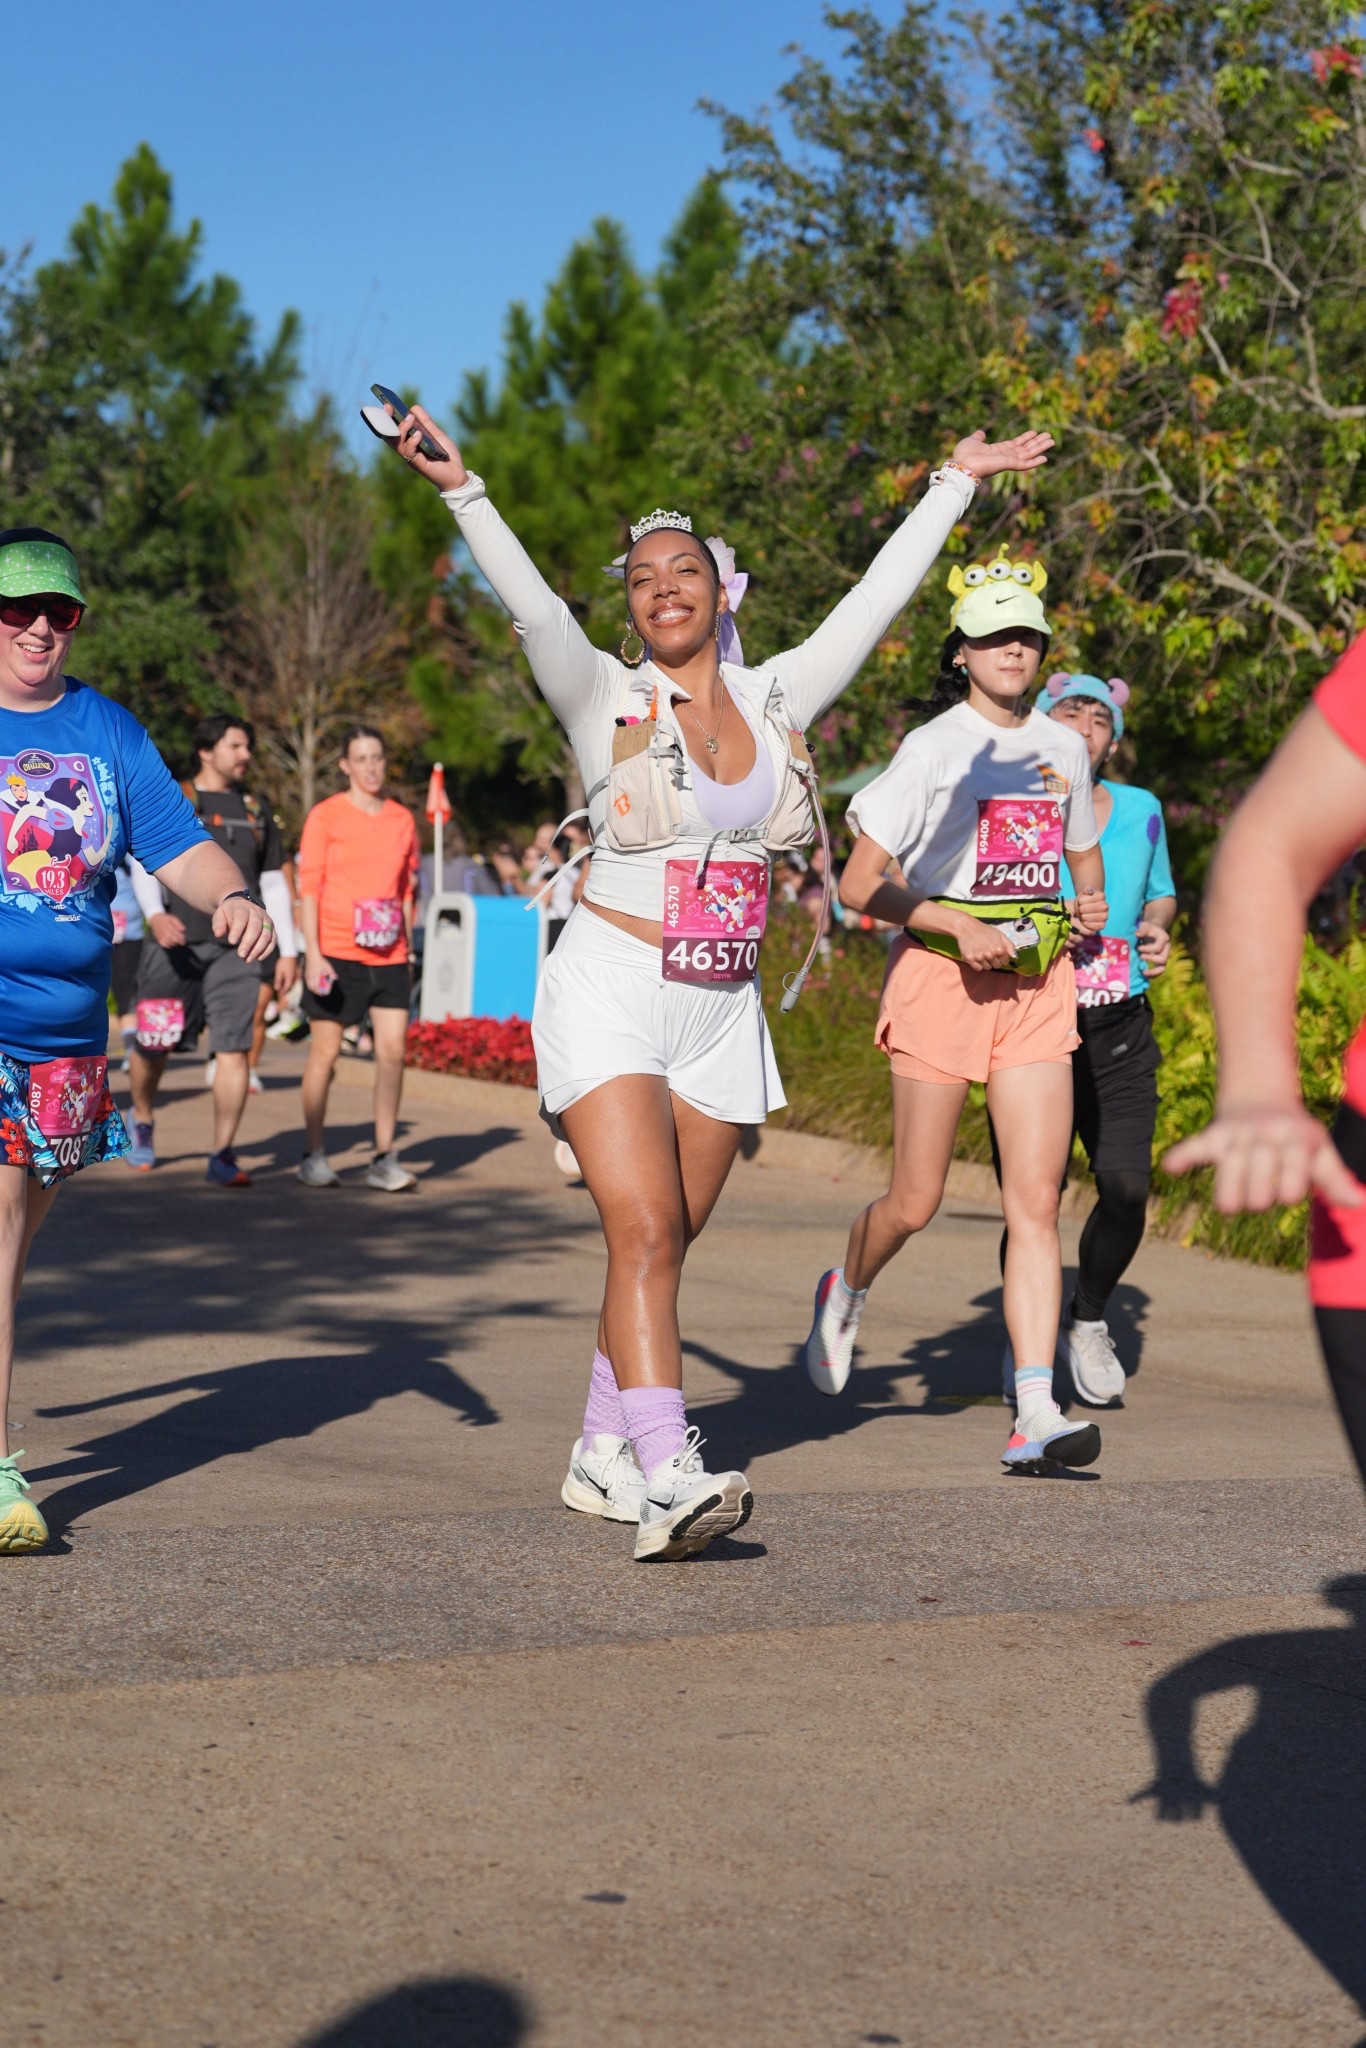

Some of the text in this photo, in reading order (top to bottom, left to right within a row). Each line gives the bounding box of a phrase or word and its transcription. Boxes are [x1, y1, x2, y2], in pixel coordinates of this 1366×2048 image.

[980, 819, 990, 855] 49400
[41, 870, 65, 888] 19.3
[978, 863, 1055, 887] 49400
[45, 888, 64, 896] MILES
[667, 885, 680, 928] 46570
[667, 940, 757, 970] 46570
[50, 1136, 89, 1166] 708
